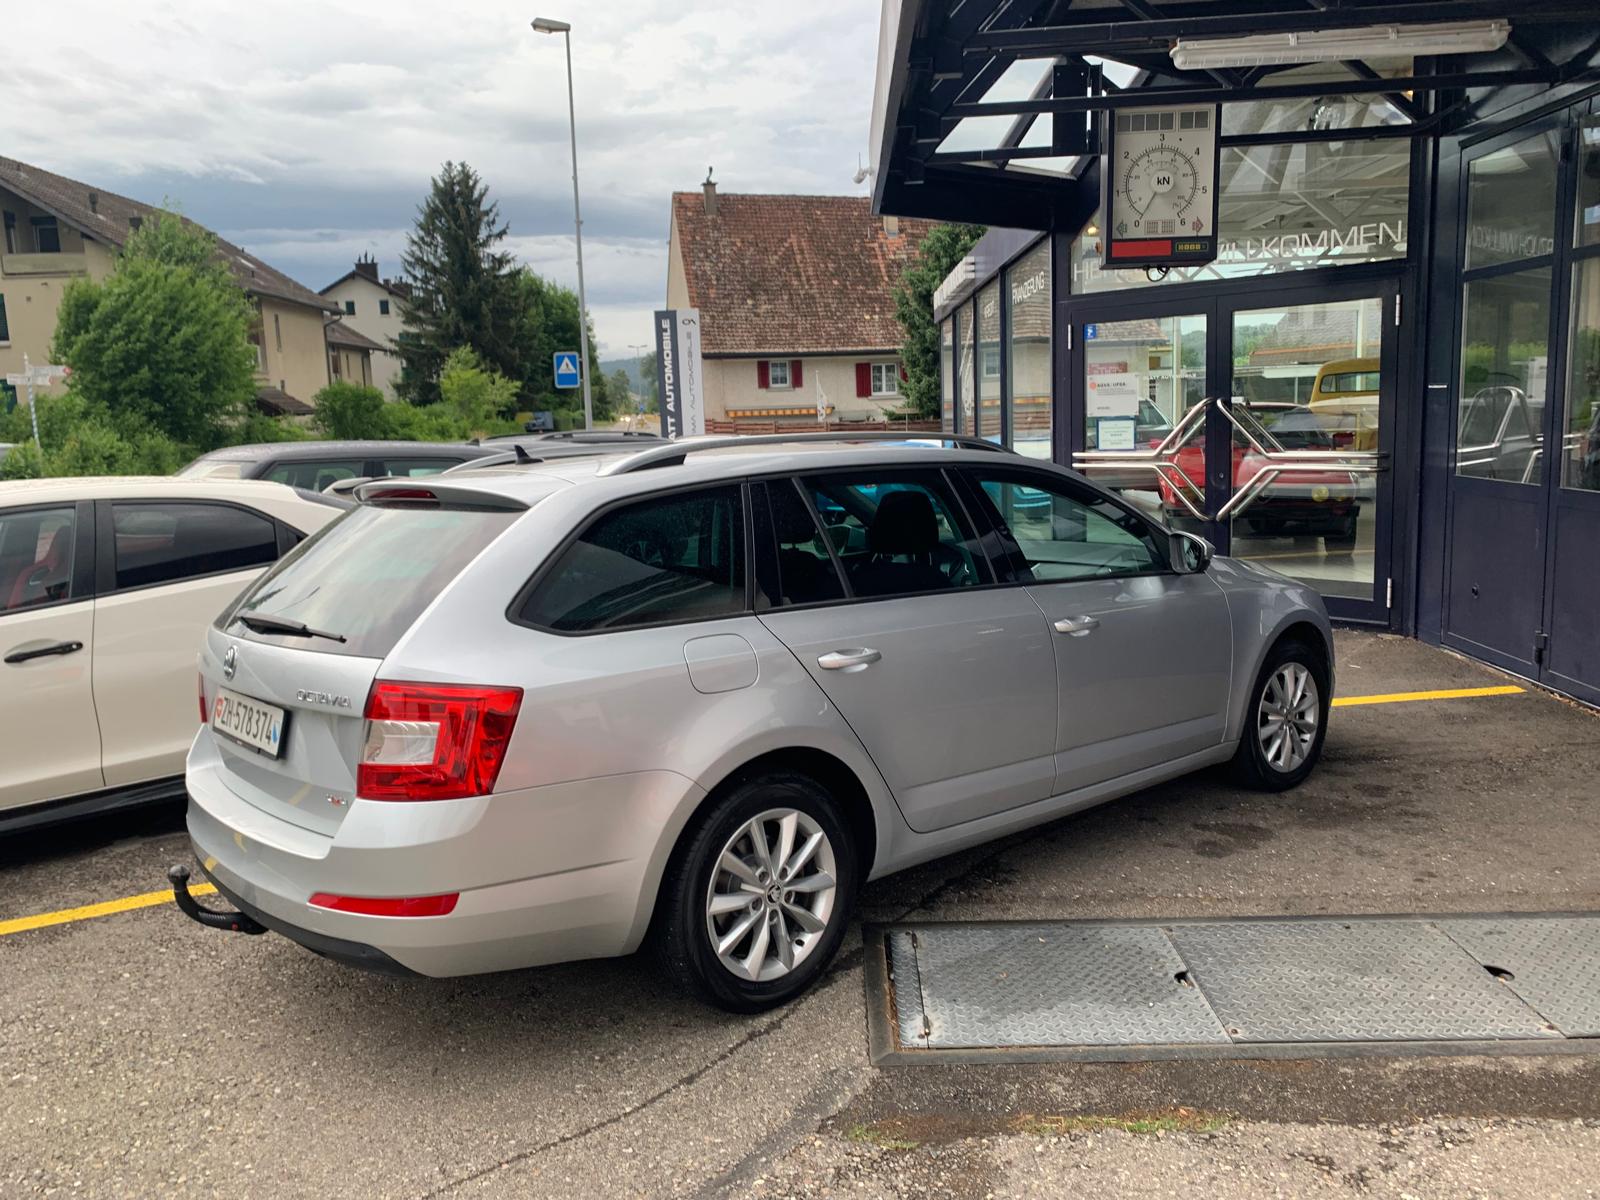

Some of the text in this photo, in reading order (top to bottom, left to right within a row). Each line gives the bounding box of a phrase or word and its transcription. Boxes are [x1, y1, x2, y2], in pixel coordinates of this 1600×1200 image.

[1159, 133, 1165, 142] 3
[1123, 151, 1130, 159] 2
[1194, 147, 1200, 156] 4
[1156, 176, 1171, 186] kN
[1201, 186, 1208, 194] 5
[1134, 219, 1140, 228] 0
[1180, 218, 1186, 227] 6
[662, 319, 675, 412] AUTOMOBILE
[296, 688, 352, 709] OCTAVIA
